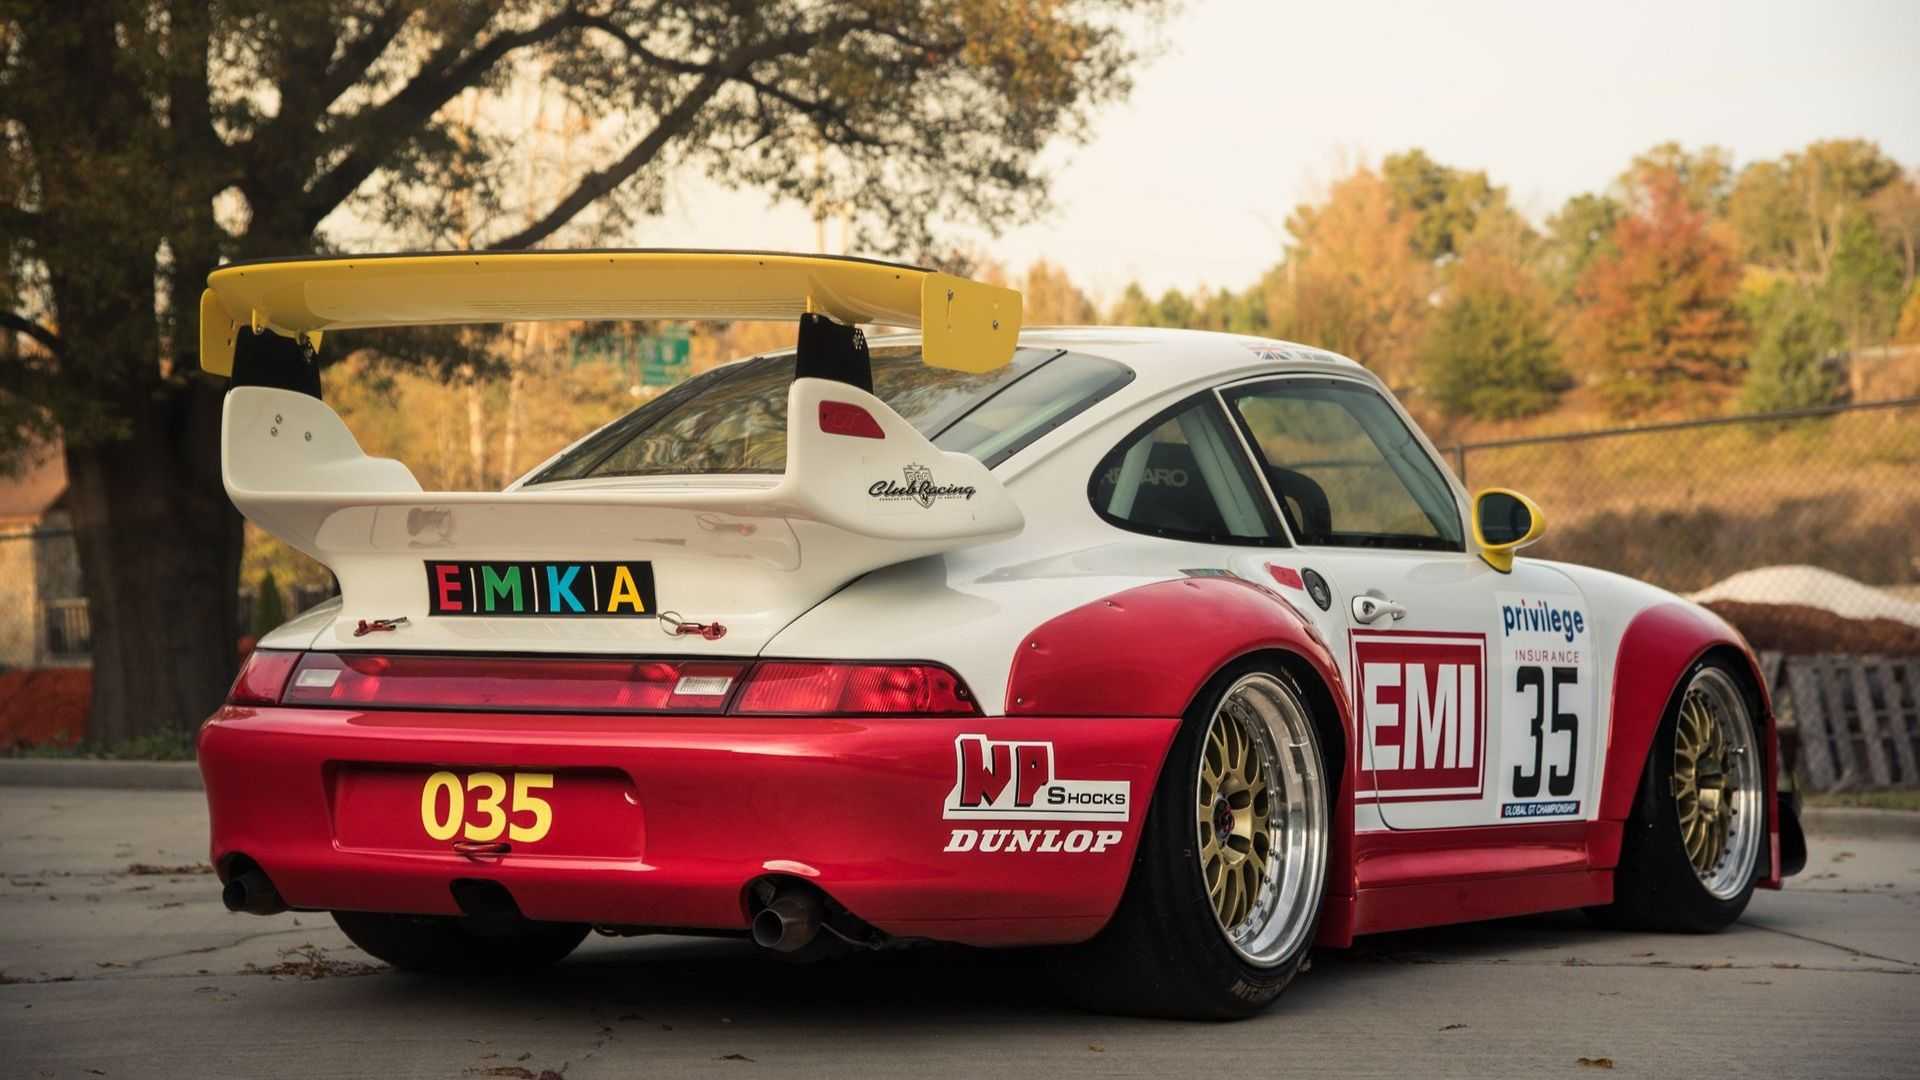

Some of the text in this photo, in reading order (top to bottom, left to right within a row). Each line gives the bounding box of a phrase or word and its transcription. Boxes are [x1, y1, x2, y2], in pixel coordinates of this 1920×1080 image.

[868, 480, 976, 501] Club Racing
[1502, 599, 1585, 643] privilege
[1515, 649, 1581, 663] INSURANCE
[1361, 662, 1476, 771] EMI
[1512, 666, 1578, 798] 35
[959, 738, 1050, 807] WP
[421, 771, 554, 843] 035
[943, 829, 1123, 853] DUNLOP
